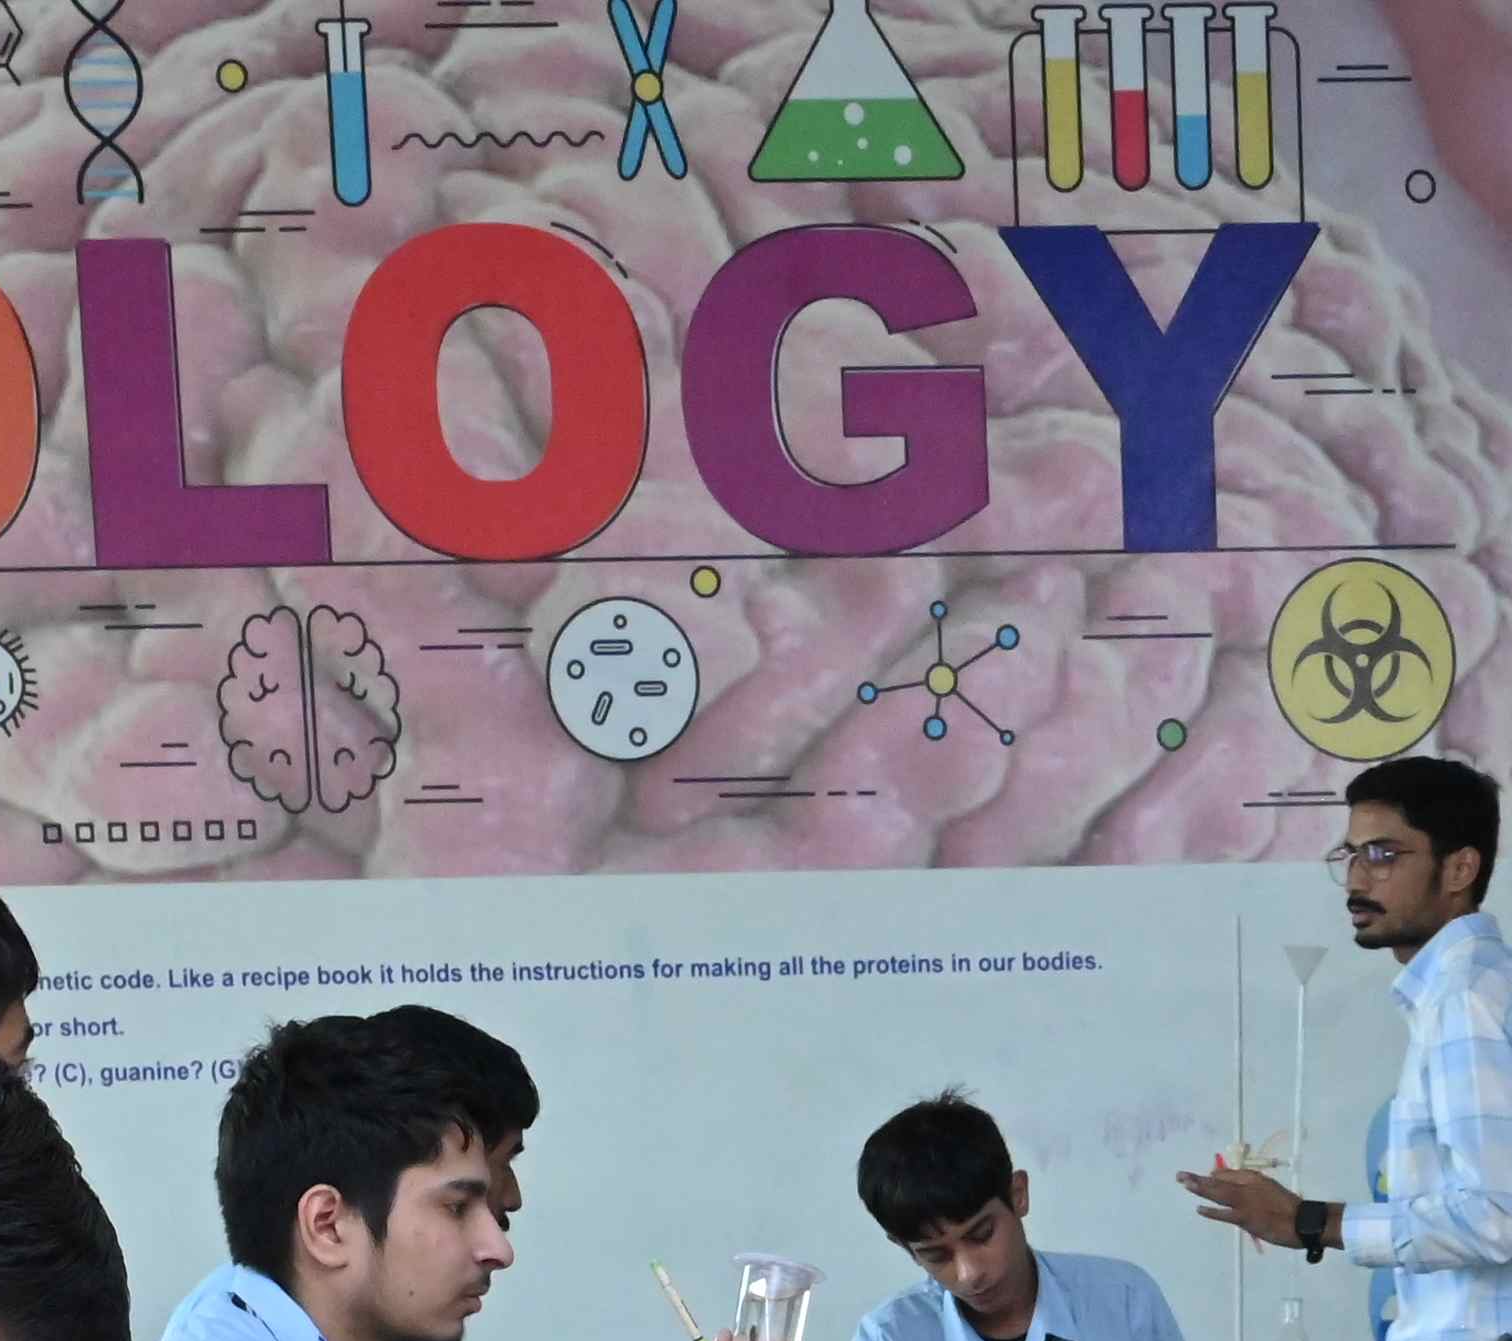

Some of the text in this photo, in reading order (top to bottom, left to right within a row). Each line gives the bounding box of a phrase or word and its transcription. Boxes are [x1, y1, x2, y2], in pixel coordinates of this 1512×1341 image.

[100, 971, 161, 991] code.
[169, 967, 214, 989] Like
[222, 971, 235, 987] a
[241, 966, 311, 992] recipe
[317, 961, 374, 985] book
[380, 962, 395, 984] it
[401, 960, 462, 983] holds
[470, 960, 505, 982] the
[512, 957, 646, 982] instructions
[652, 956, 684, 979] for
[690, 954, 772, 982] making
[779, 952, 805, 976] all
[811, 952, 846, 976] the
[852, 951, 944, 979] proteins
[952, 951, 971, 972] in
[979, 955, 1015, 972] our
[1022, 950, 1103, 972] bodies.
[59, 1011, 125, 1037] short.
[54, 1061, 93, 1087] (C),
[100, 1060, 203, 1086] guanine?
